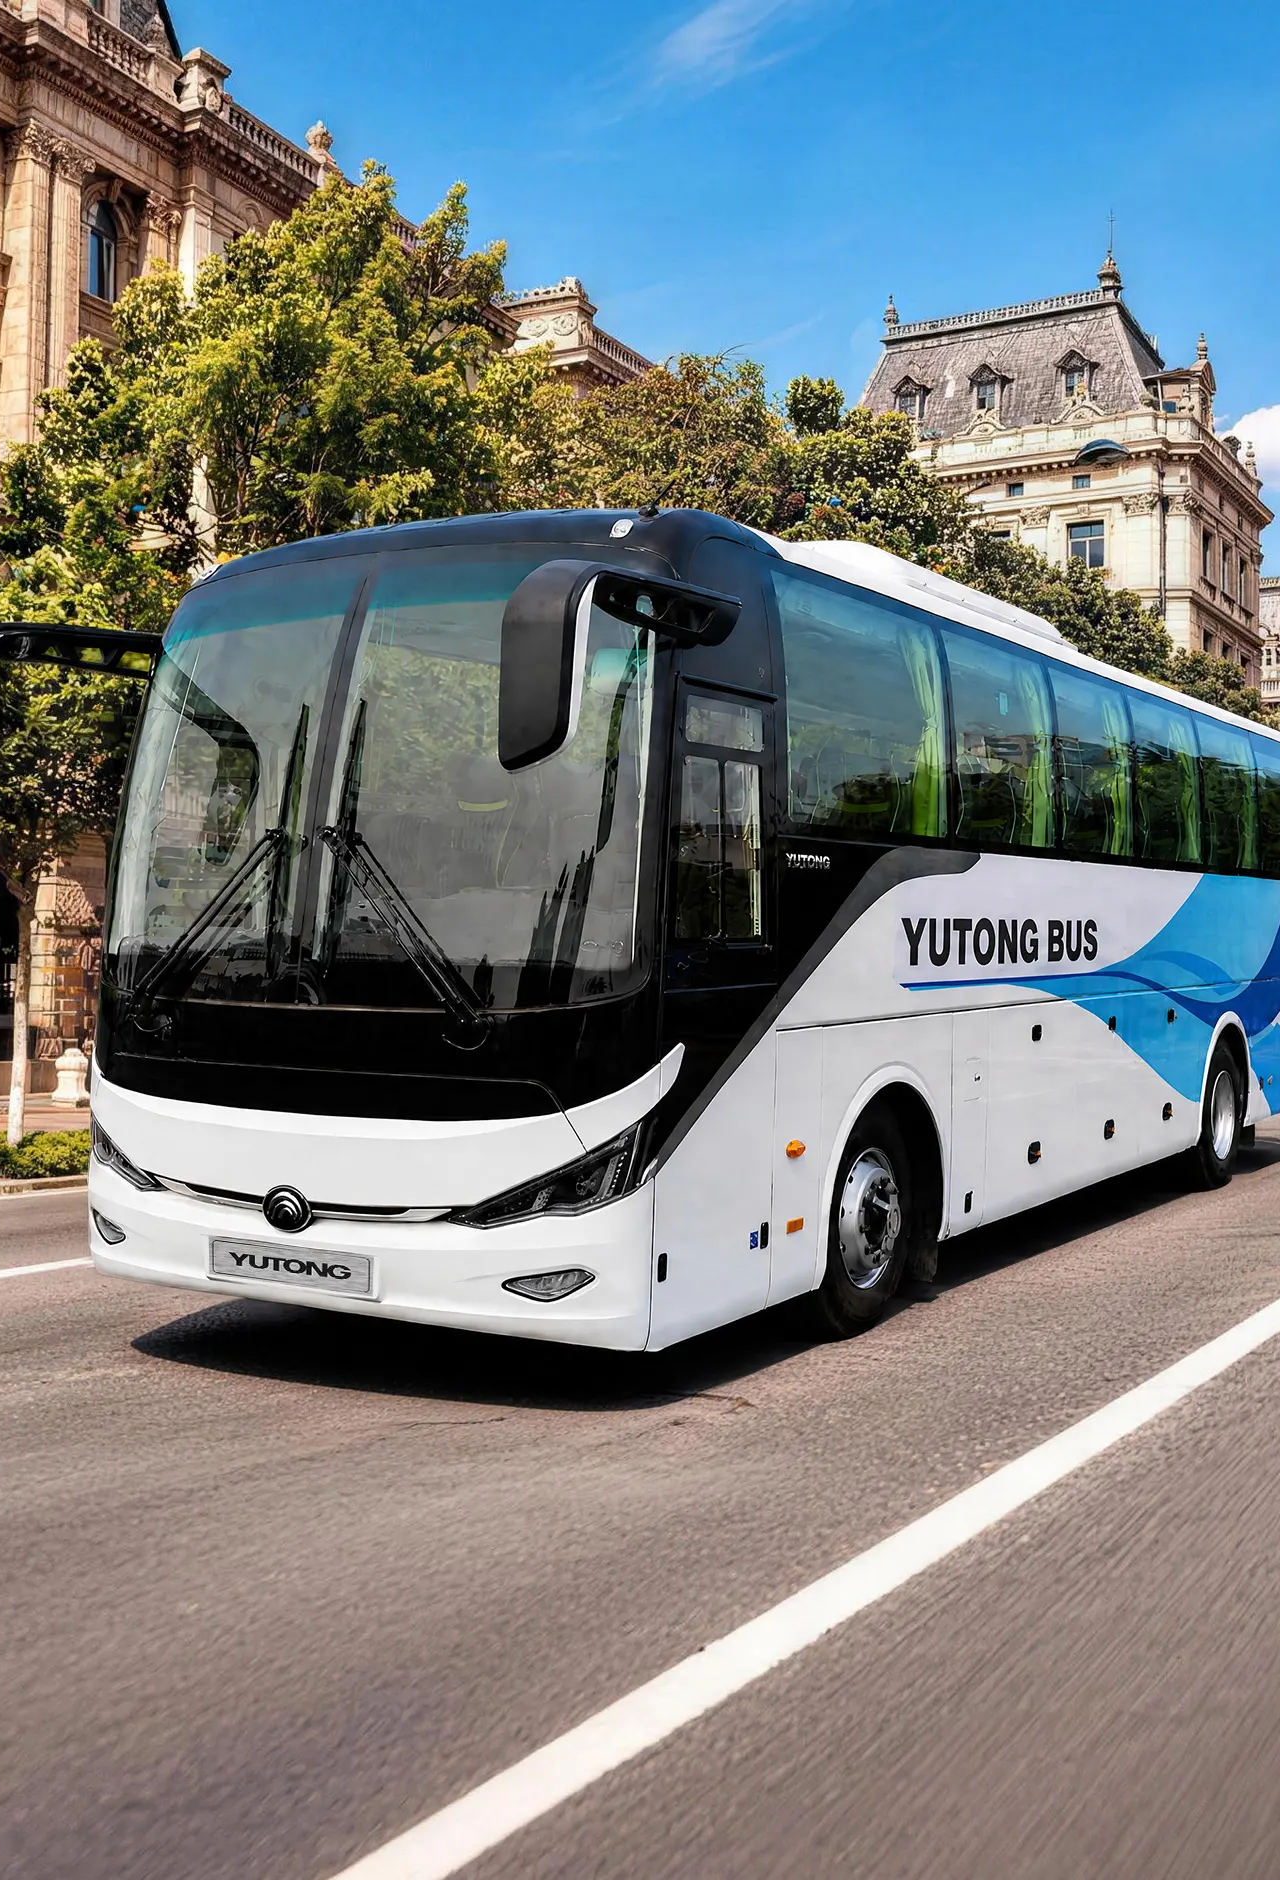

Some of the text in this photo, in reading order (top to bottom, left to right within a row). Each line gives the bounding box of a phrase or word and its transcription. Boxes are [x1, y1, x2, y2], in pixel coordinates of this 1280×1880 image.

[785, 852, 831, 869] YUTONG
[900, 917, 1098, 967] YUTONG BUS
[228, 1251, 352, 1280] YUTONG
